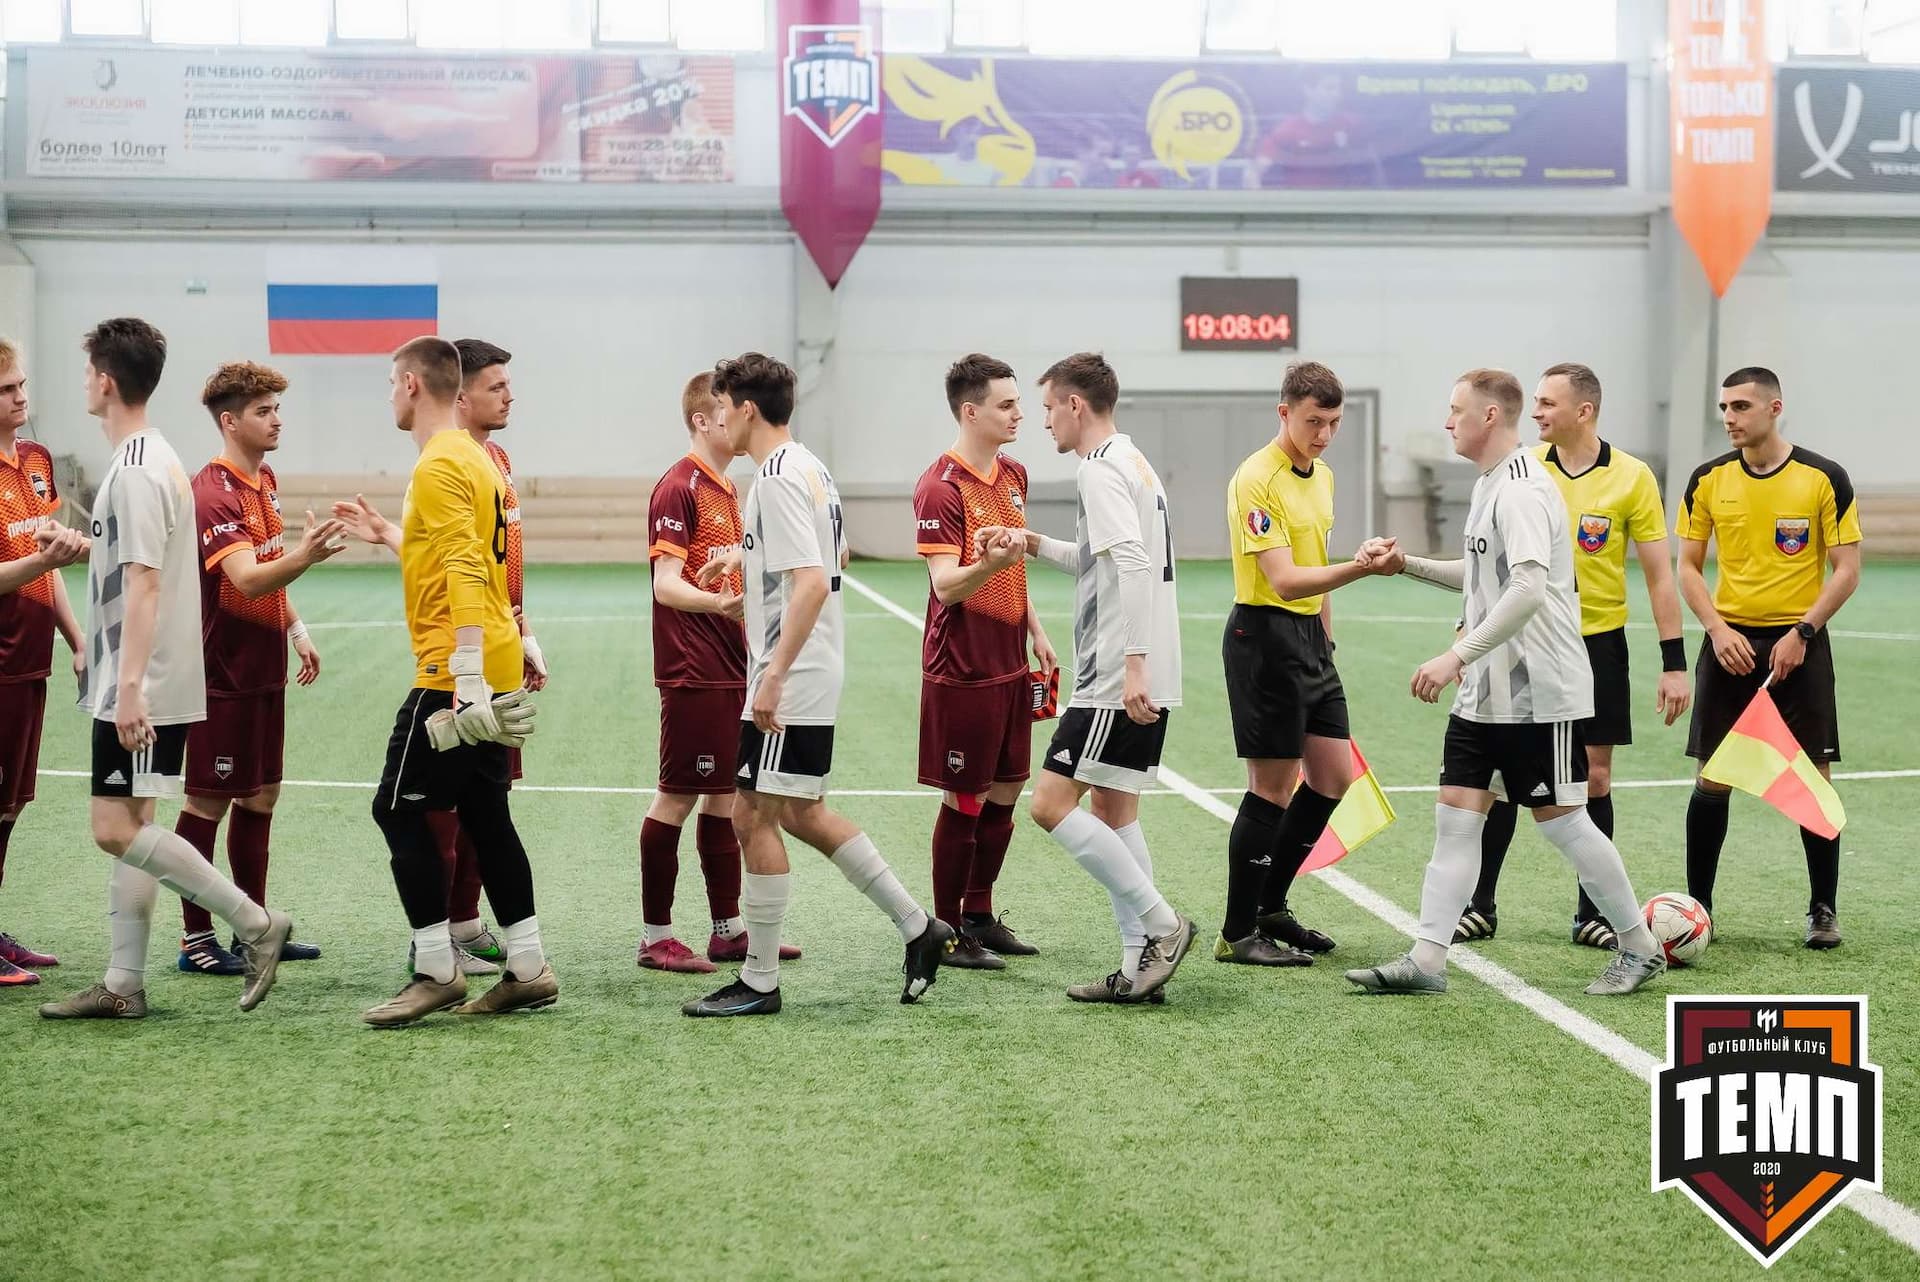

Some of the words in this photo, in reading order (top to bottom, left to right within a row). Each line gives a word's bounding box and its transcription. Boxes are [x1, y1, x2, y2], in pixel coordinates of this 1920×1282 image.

[792, 58, 870, 101] ТЕМП
[1679, 81, 1766, 118] ТОЛЬКО
[184, 106, 265, 122] ДЕТСКИЙ
[40, 138, 103, 157] более
[1184, 314, 1290, 340] 19:08:04
[212, 521, 238, 535] ПСБ
[662, 516, 684, 532] ПСБ
[917, 519, 940, 530] ПСБ
